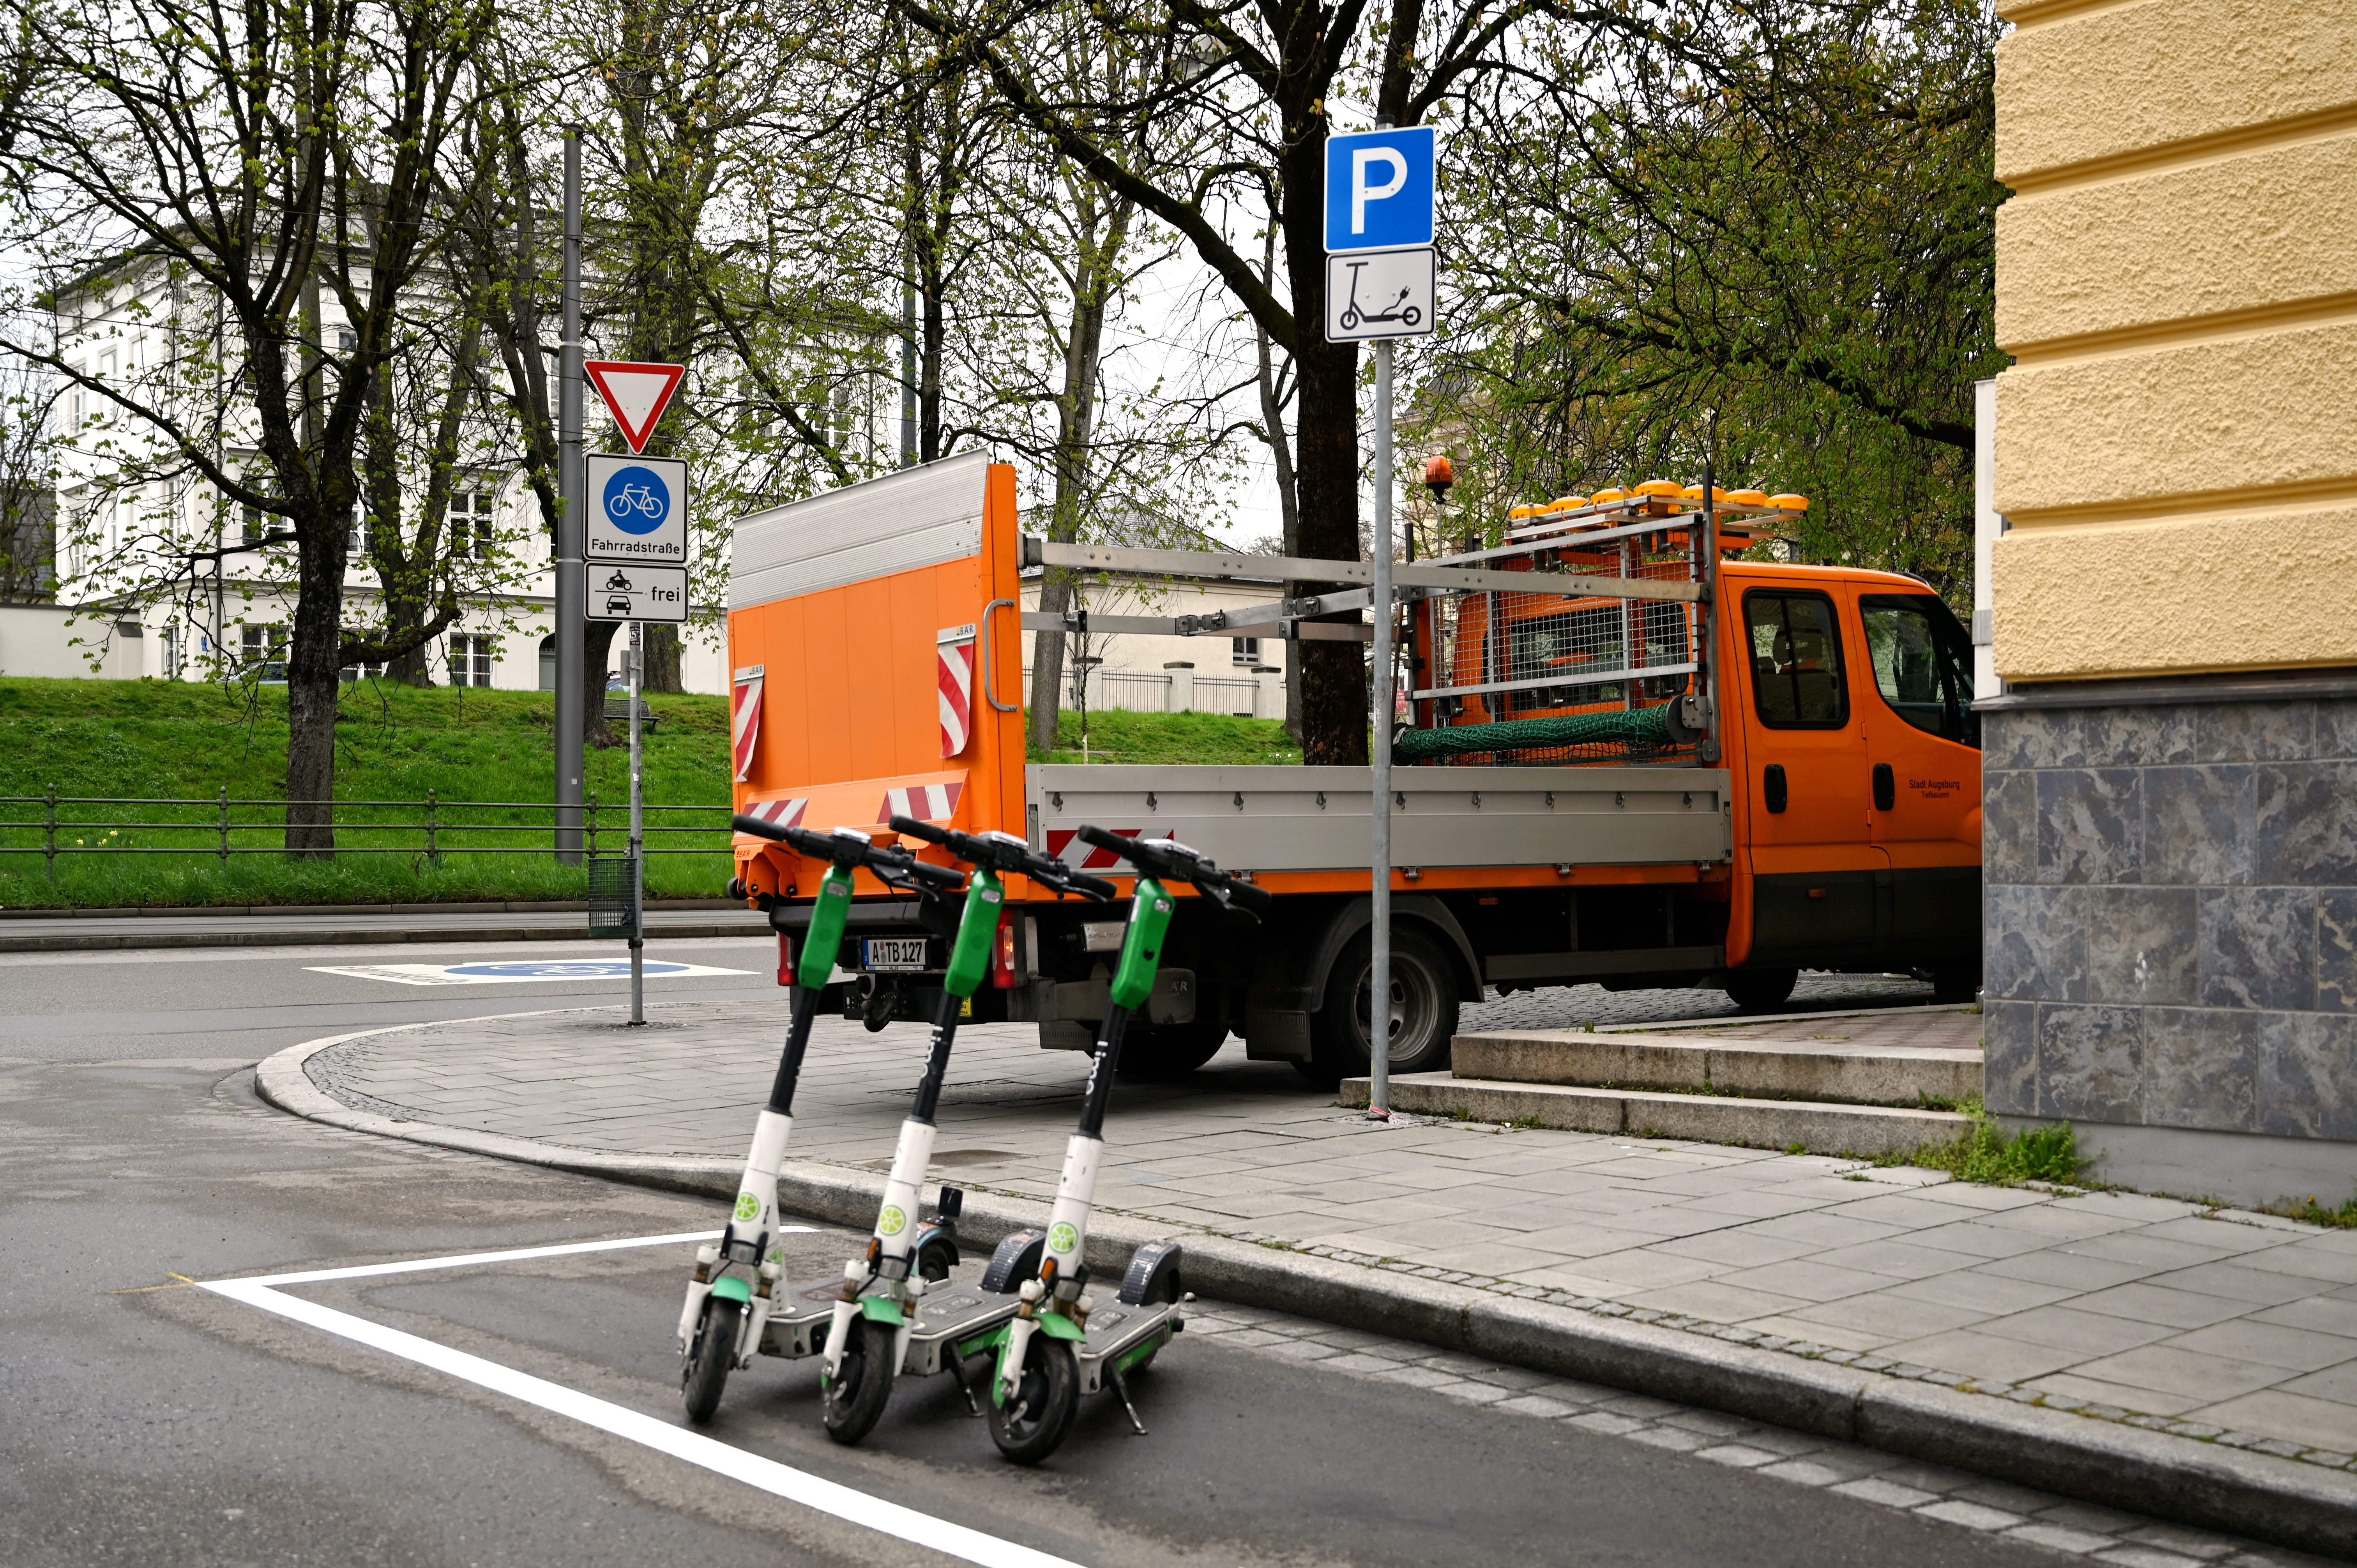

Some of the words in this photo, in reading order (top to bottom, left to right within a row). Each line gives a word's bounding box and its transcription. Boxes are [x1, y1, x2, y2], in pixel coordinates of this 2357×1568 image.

[1352, 147, 1408, 234] P
[592, 539, 680, 554] Fahrradstraße
[652, 586, 680, 602] frei
[960, 625, 974, 635] BÄR
[1910, 779, 1926, 789] Stadt
[1928, 779, 1960, 790] Augsburg
[902, 942, 922, 962] 127
